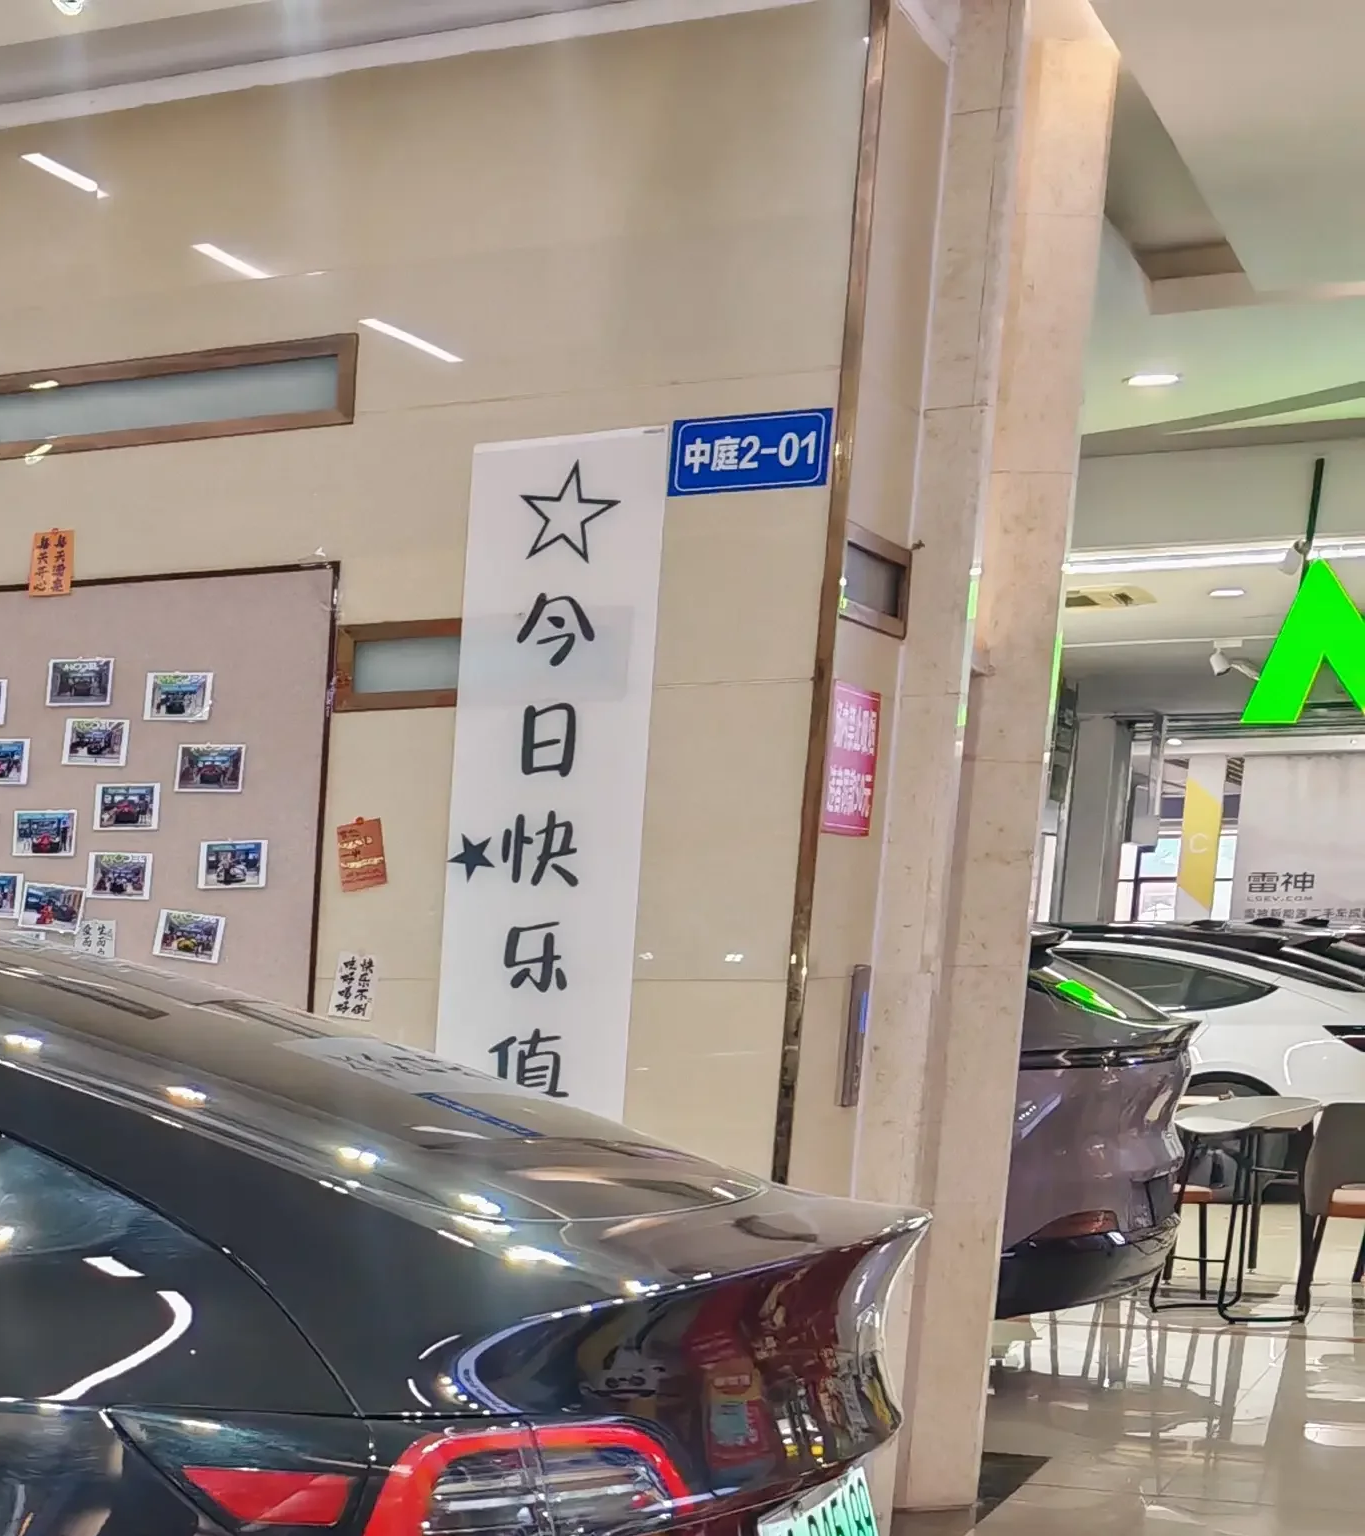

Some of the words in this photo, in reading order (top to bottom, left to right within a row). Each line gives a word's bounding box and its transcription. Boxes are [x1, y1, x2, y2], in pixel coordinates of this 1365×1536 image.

[682, 428, 819, 474] 中庭2-01
[489, 591, 596, 1099] 今日快乐值
[1247, 871, 1315, 893] 雷神
